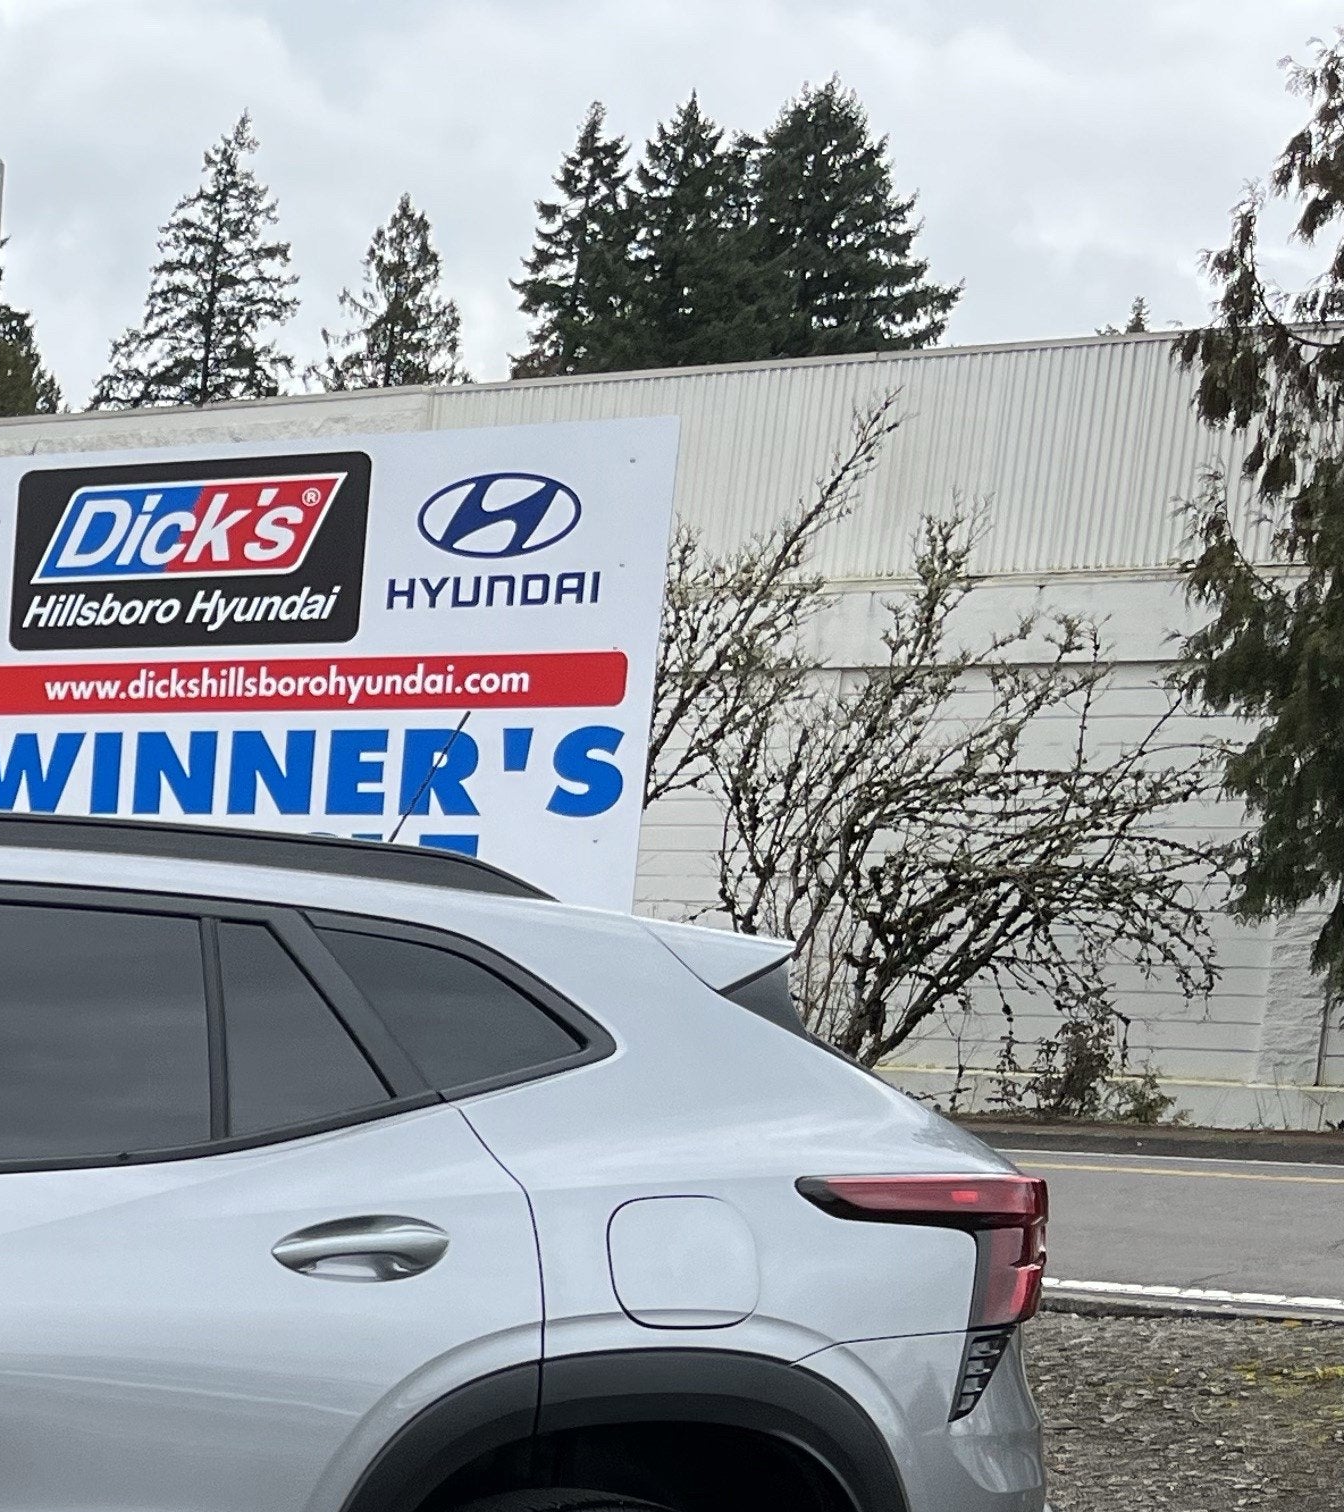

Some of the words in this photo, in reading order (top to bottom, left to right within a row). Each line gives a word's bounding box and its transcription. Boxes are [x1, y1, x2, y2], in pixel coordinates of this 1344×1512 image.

[55, 488, 303, 569] Dick's
[22, 592, 181, 629] Hillsboro
[185, 585, 342, 631] Hyundai
[386, 571, 601, 610] HYUNDAI
[44, 663, 530, 704] www.dickshillsborohyundai.com
